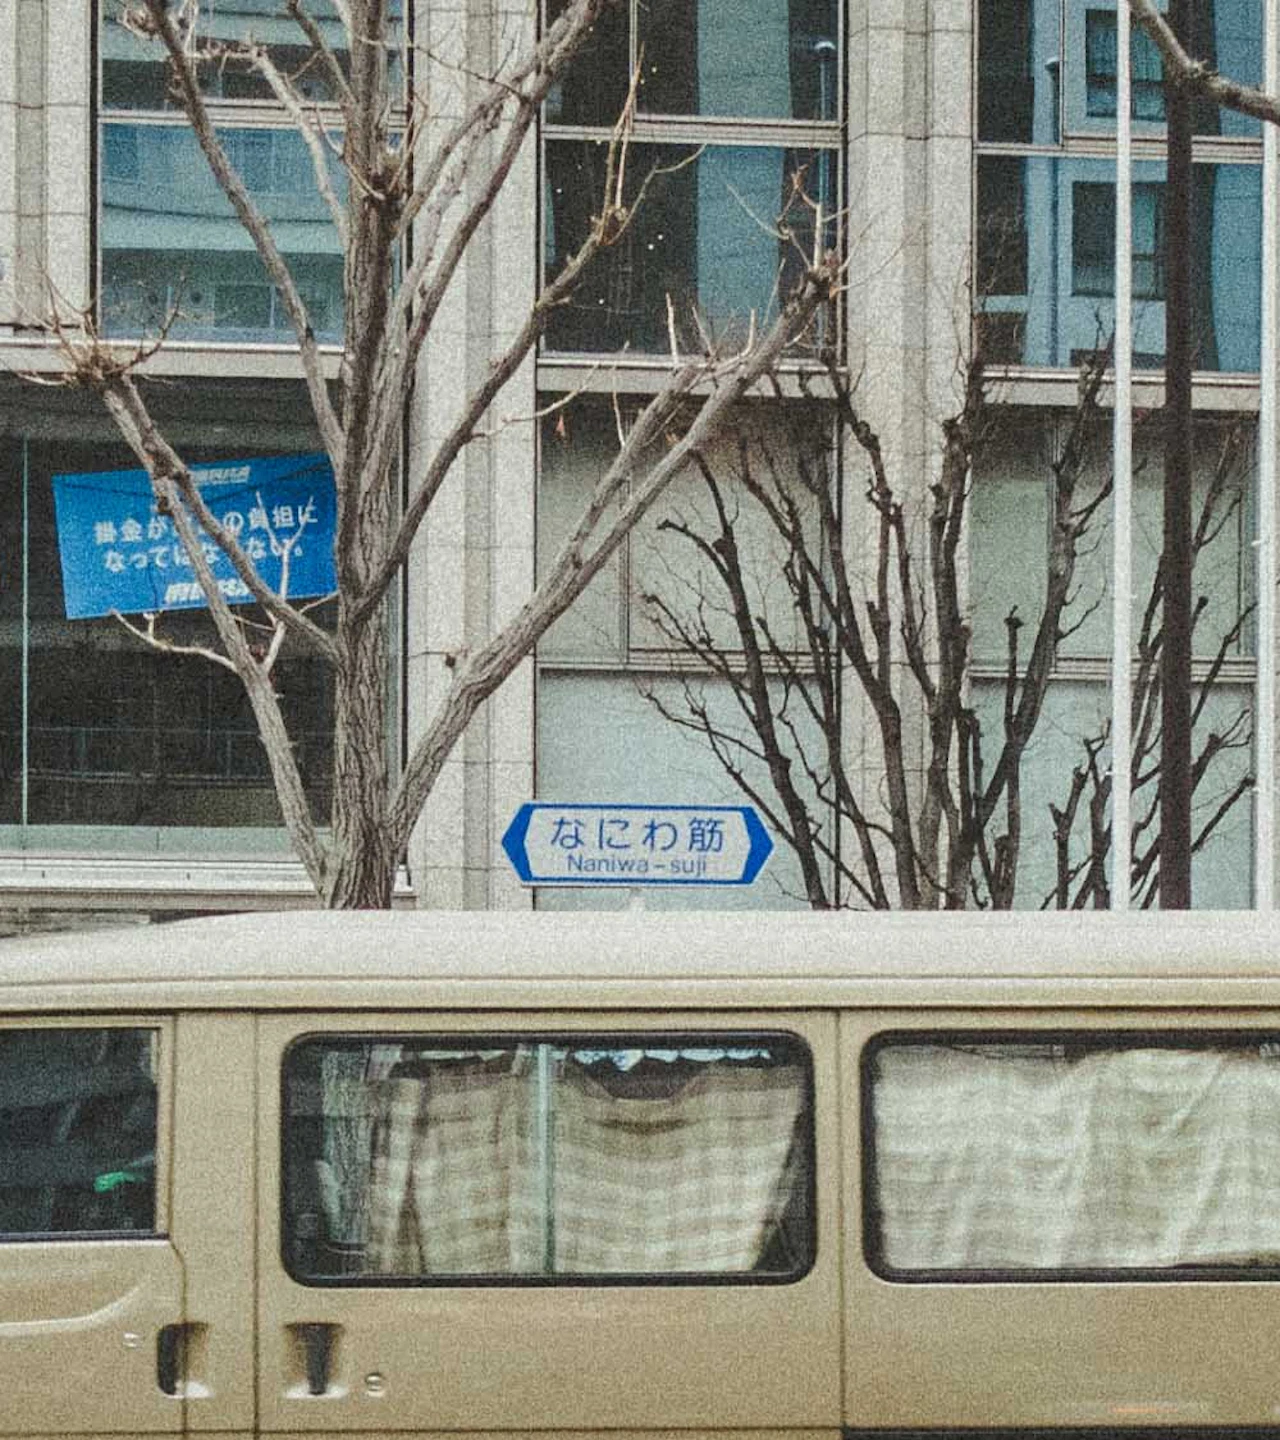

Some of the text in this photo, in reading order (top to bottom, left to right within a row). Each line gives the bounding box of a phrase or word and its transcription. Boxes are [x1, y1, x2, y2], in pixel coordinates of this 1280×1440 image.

[94, 505, 319, 545] 掛金がの負担に
[106, 538, 303, 573] なってはなない。
[550, 816, 724, 853] なにわ筋
